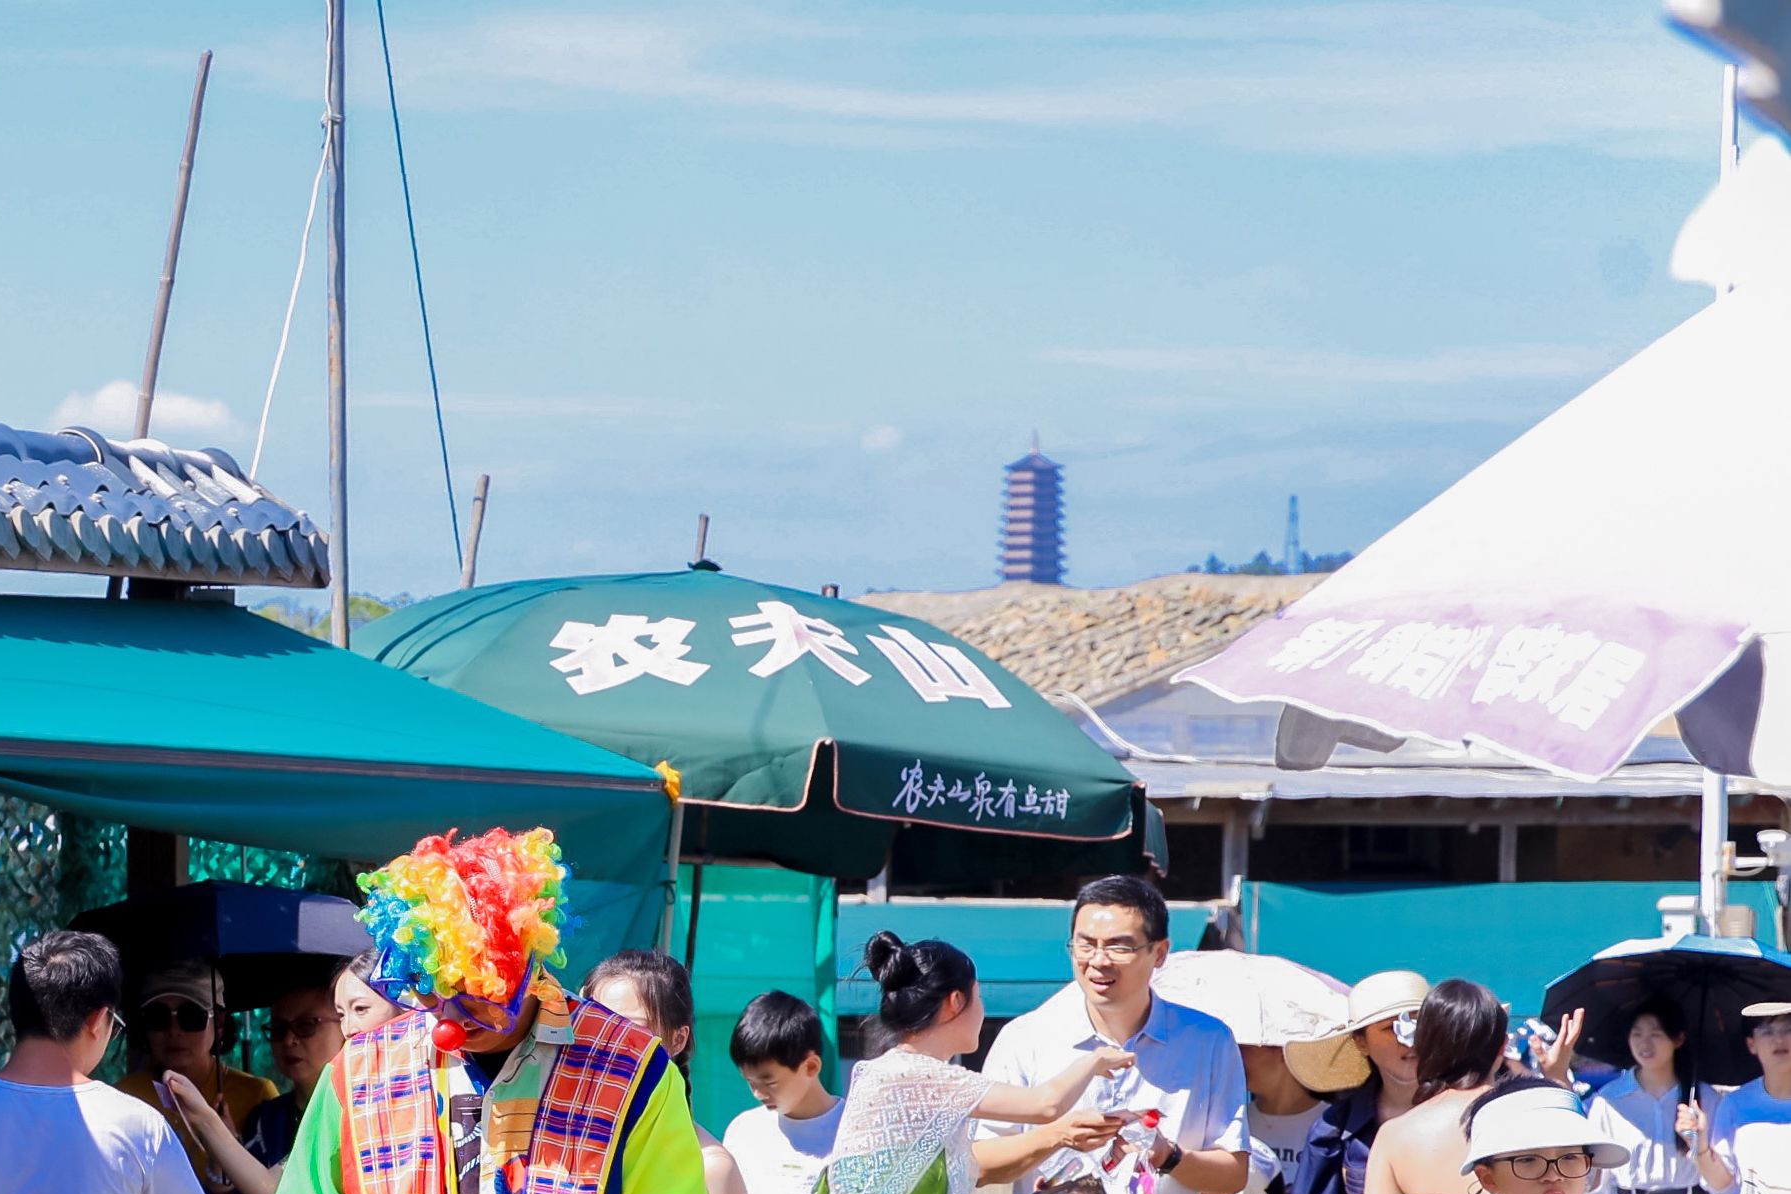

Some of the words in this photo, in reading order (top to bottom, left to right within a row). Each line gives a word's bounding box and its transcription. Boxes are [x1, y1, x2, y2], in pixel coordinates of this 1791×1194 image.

[549, 600, 1012, 709] 农夫山
[892, 758, 1071, 822] 农夫山泉有点甜
